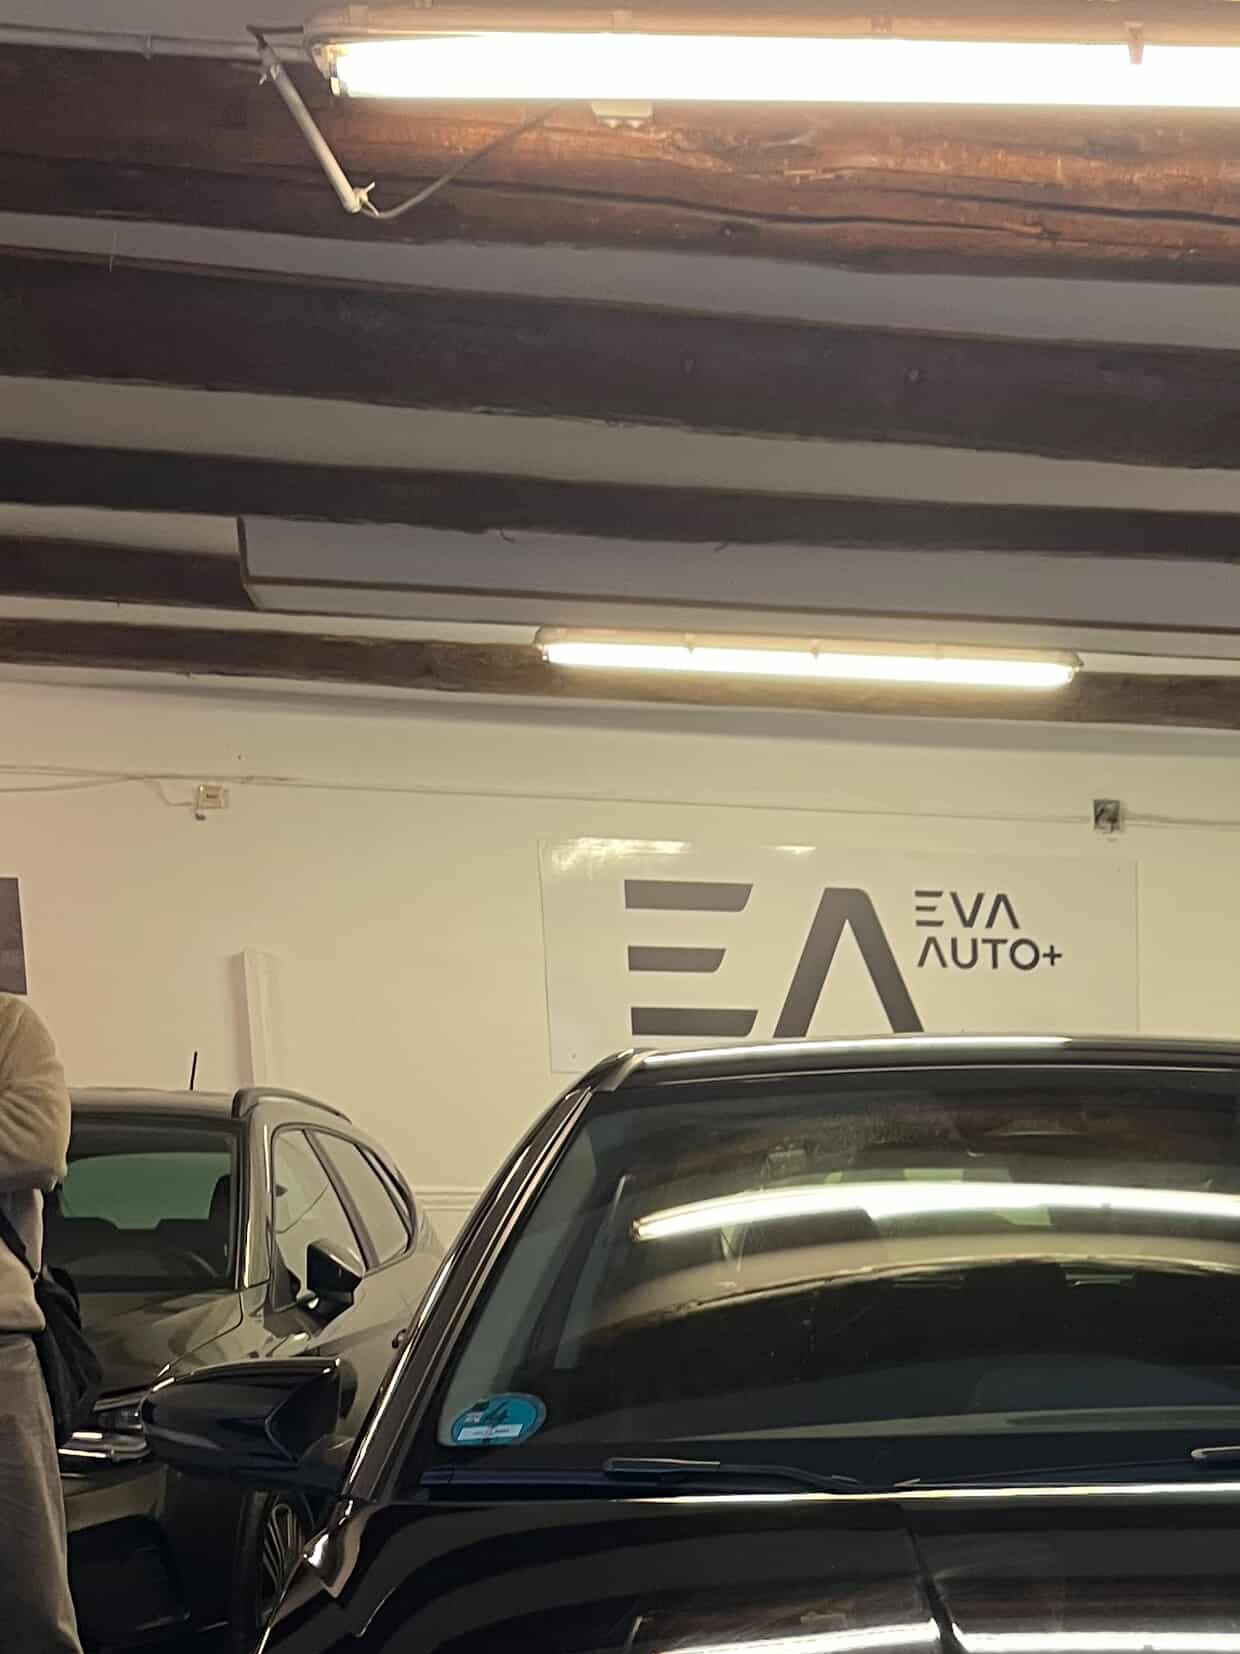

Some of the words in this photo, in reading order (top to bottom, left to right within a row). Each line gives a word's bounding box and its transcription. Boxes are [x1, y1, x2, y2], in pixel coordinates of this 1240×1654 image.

[914, 889, 1020, 930] EVA
[623, 879, 925, 1038] EA
[916, 936, 1064, 971] AUTO+
